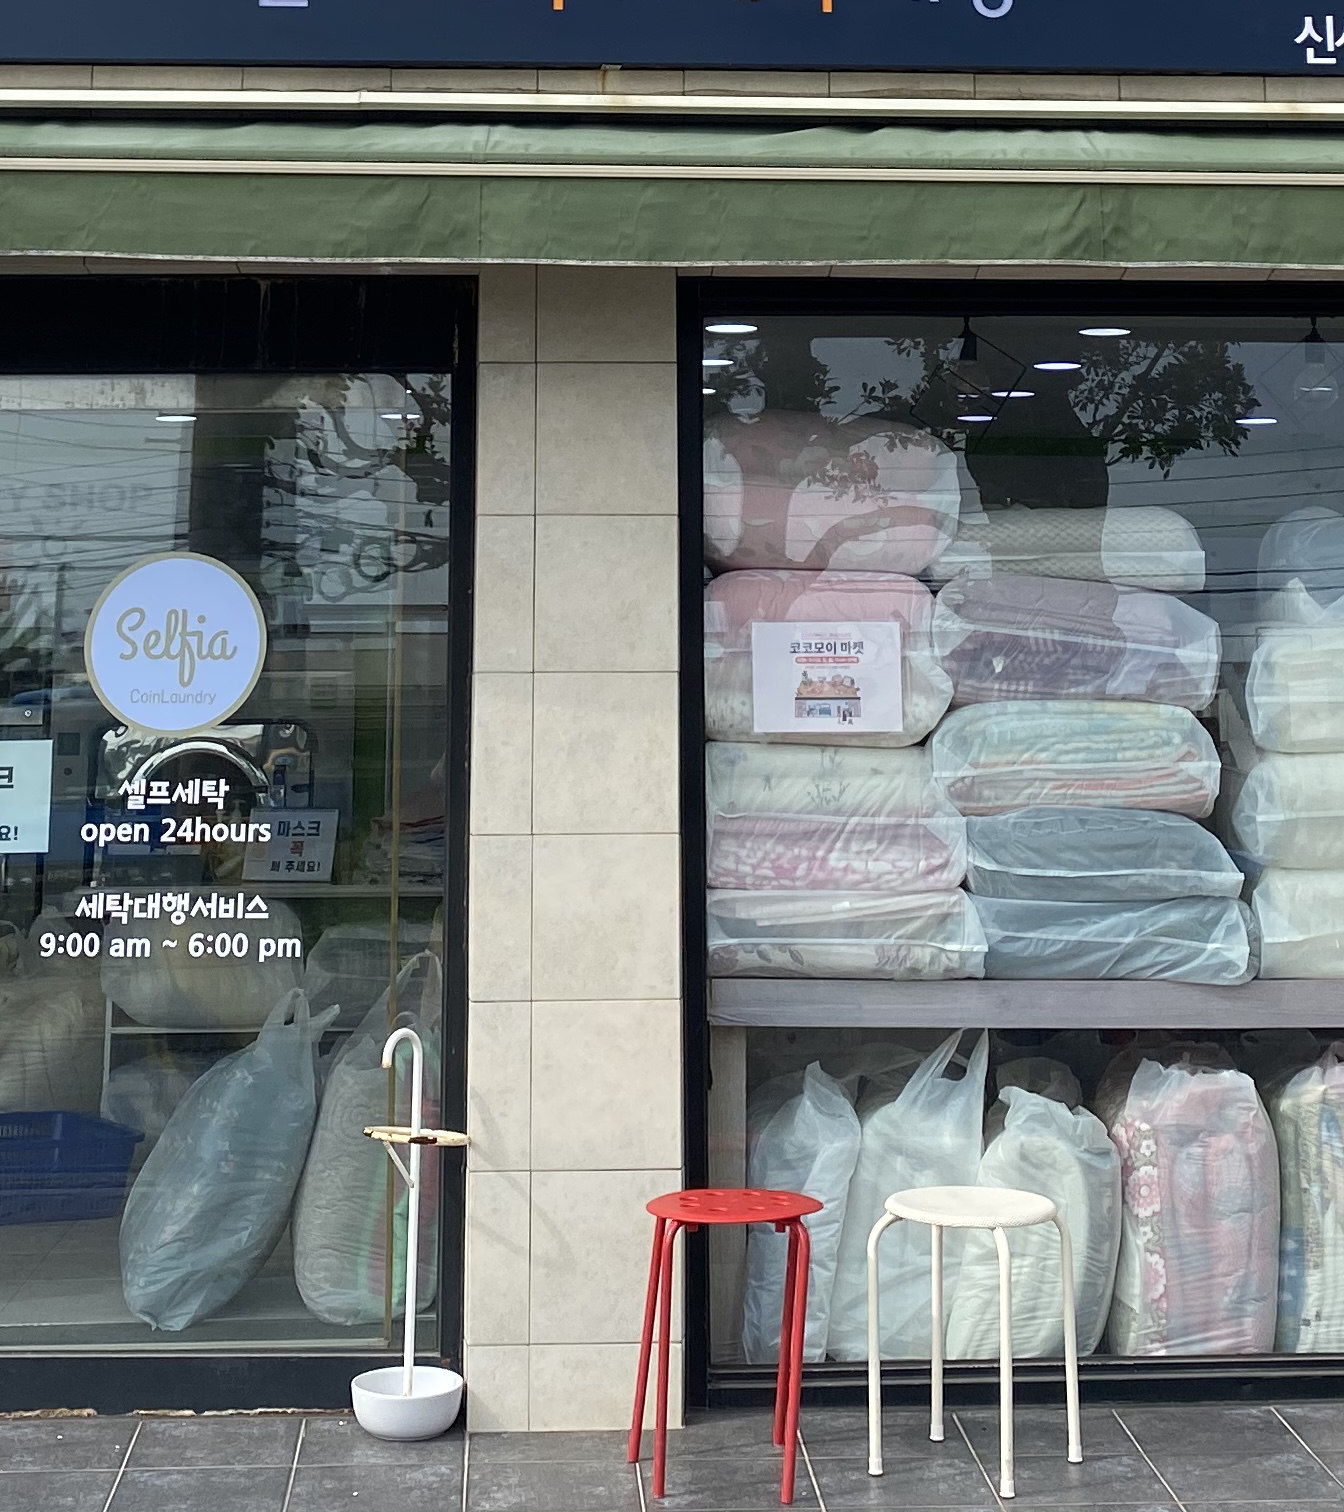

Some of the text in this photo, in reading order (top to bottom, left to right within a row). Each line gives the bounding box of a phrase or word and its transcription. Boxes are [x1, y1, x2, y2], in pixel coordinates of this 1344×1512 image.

[116, 606, 238, 688] Selfia
[789, 641, 864, 655] 코코모이 마켓
[130, 688, 216, 705] CoinLaundry
[117, 777, 230, 810] 셀프세탁
[80, 816, 271, 847] open 24hours
[277, 820, 321, 837] 마스크
[290, 840, 304, 857] 꼭
[285, 860, 321, 873] 주세요!
[74, 892, 269, 925] 세탁대행서비스
[39, 932, 100, 958] 9:00
[109, 938, 151, 958] am
[188, 932, 249, 958] 6:00
[258, 938, 302, 962] pm
